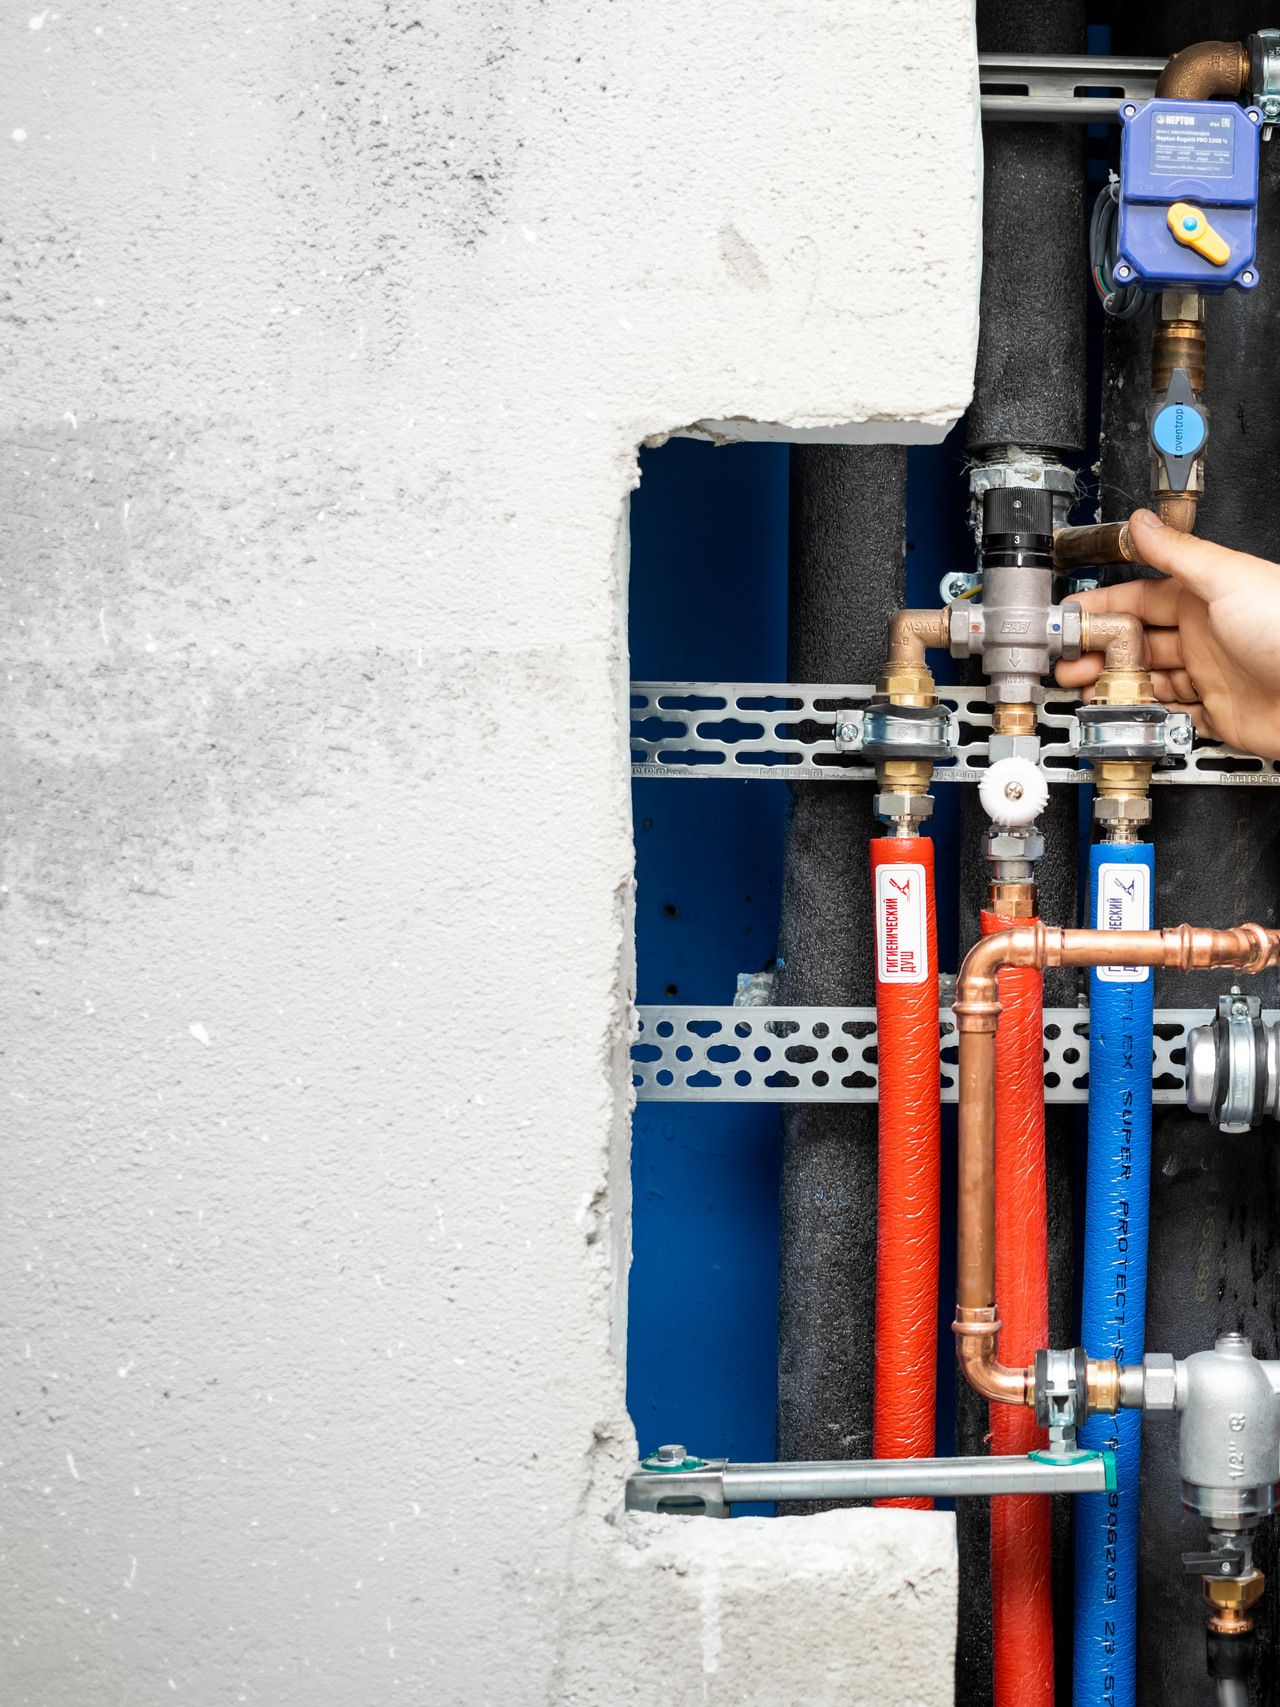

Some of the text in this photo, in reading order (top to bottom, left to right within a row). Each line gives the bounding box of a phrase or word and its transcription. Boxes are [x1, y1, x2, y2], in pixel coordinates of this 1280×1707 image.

[1166, 115, 1195, 125] NEPTUN
[1174, 408, 1185, 451] oventrop
[1014, 536, 1020, 544] 3
[1048, 538, 1052, 546] 2
[1001, 620, 1031, 634] FAR
[1004, 674, 1025, 684] MIX
[883, 898, 898, 973] ГИГИЕНИЧЕСКИЙ
[900, 951, 916, 973] ДУШ
[1120, 1090, 1132, 1180] SUPER
